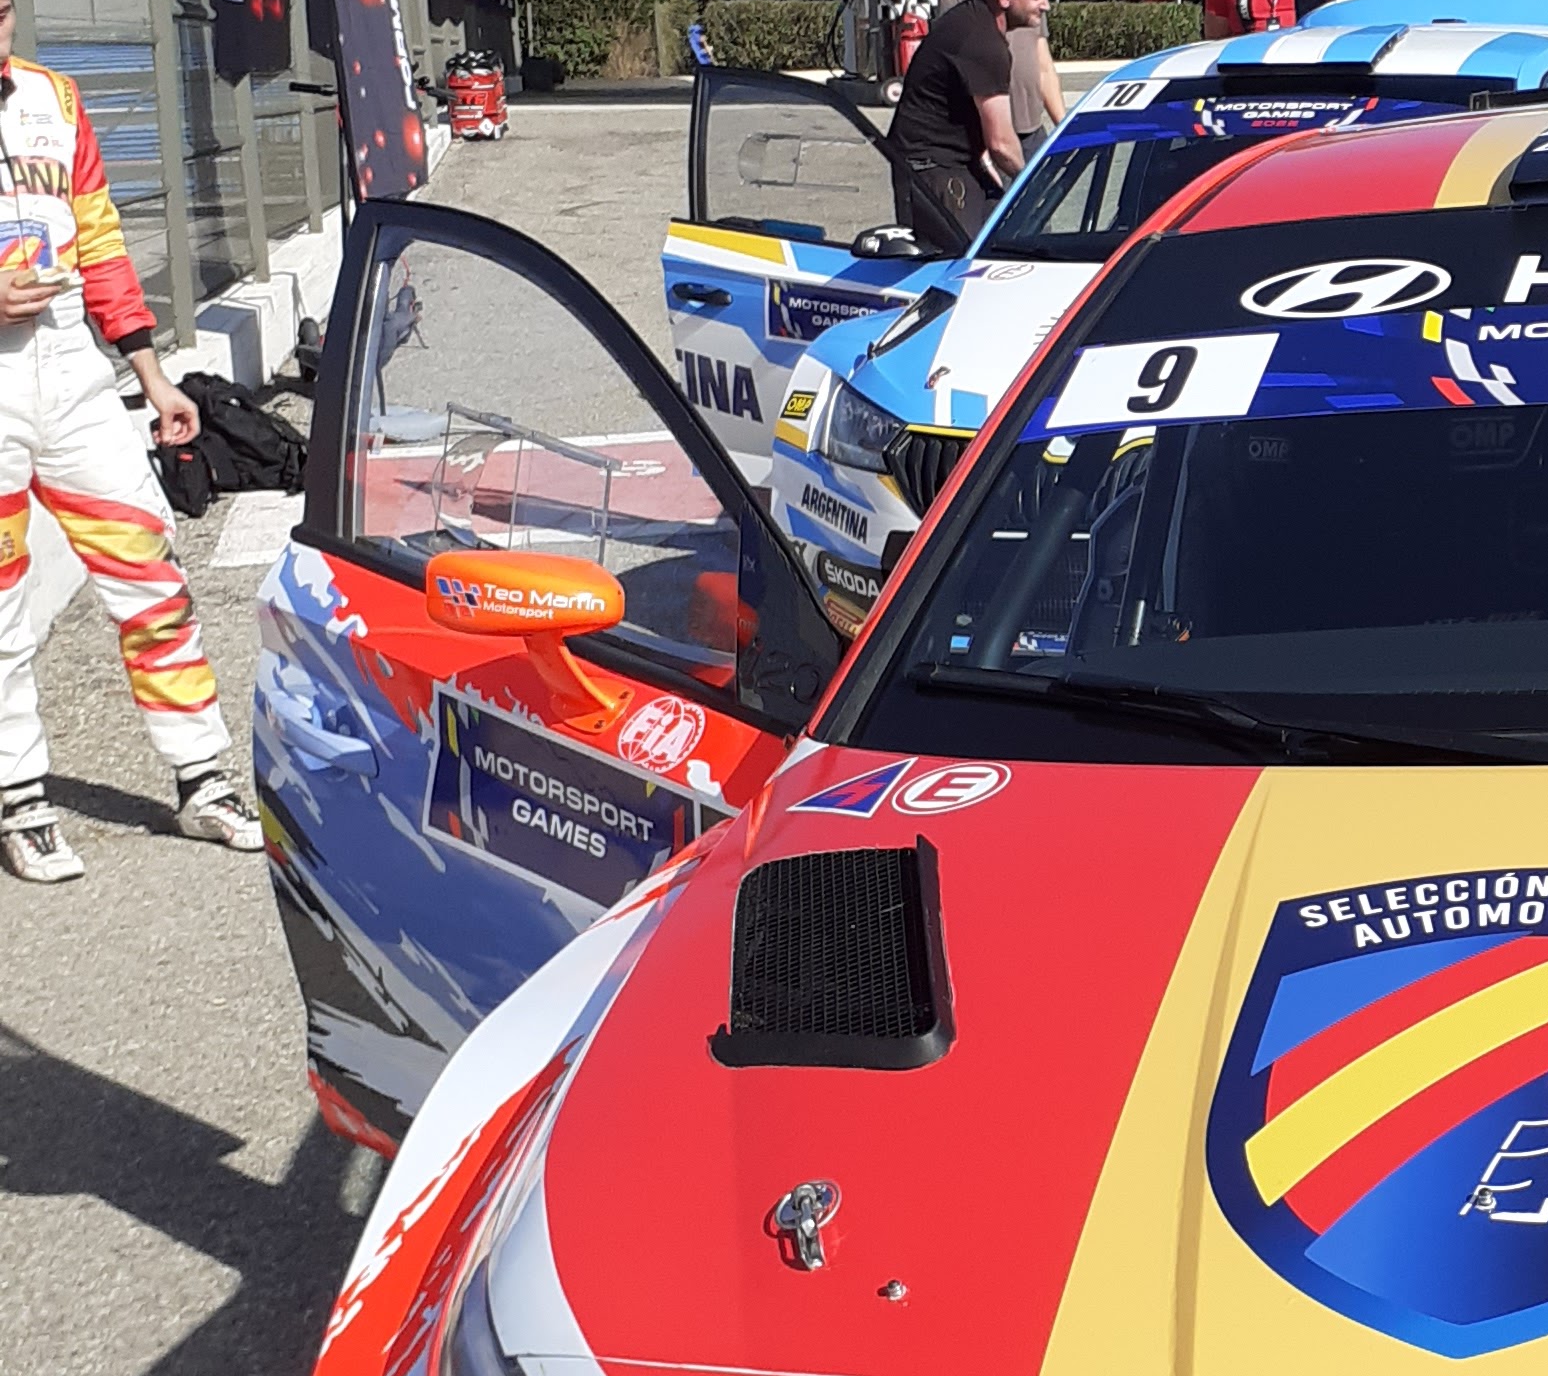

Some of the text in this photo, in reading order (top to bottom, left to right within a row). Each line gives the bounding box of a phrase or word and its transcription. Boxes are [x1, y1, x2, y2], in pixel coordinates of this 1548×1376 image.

[1102, 81, 1148, 108] 10
[1214, 101, 1355, 113] MOTORSPORT
[1241, 110, 1316, 120] GAMES
[788, 296, 880, 317] MOTORSPO
[1126, 345, 1199, 414] 9
[785, 395, 812, 414] OMP
[800, 482, 869, 545] ARGENTINA
[823, 558, 880, 598] ŠKODA
[483, 583, 524, 603] Teo
[483, 600, 555, 620] Motorsport
[622, 703, 688, 760] FIA
[473, 742, 655, 844] MOTORSPORT
[511, 798, 607, 860] GAMES
